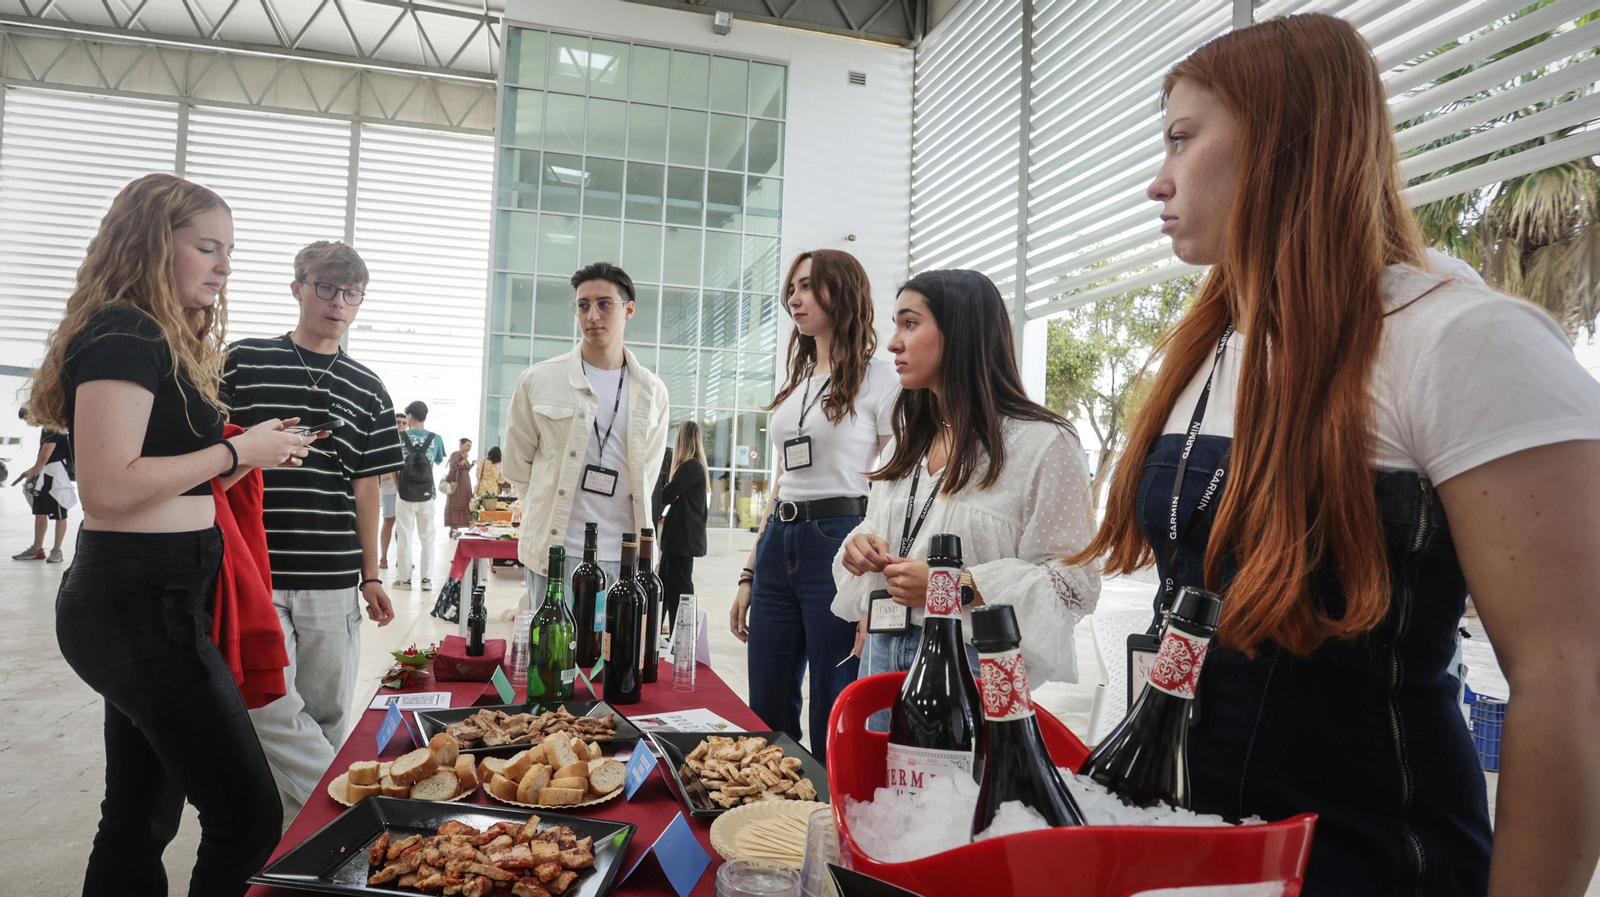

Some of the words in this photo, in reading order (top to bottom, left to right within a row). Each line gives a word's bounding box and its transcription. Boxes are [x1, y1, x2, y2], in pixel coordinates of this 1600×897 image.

[1217, 322, 1235, 354] GARMIN
[1182, 421, 1201, 459] GARMIN
[920, 497, 933, 519] GARMIN
[1197, 468, 1225, 511] GARMIN
[1169, 496, 1179, 539] GARMIN
